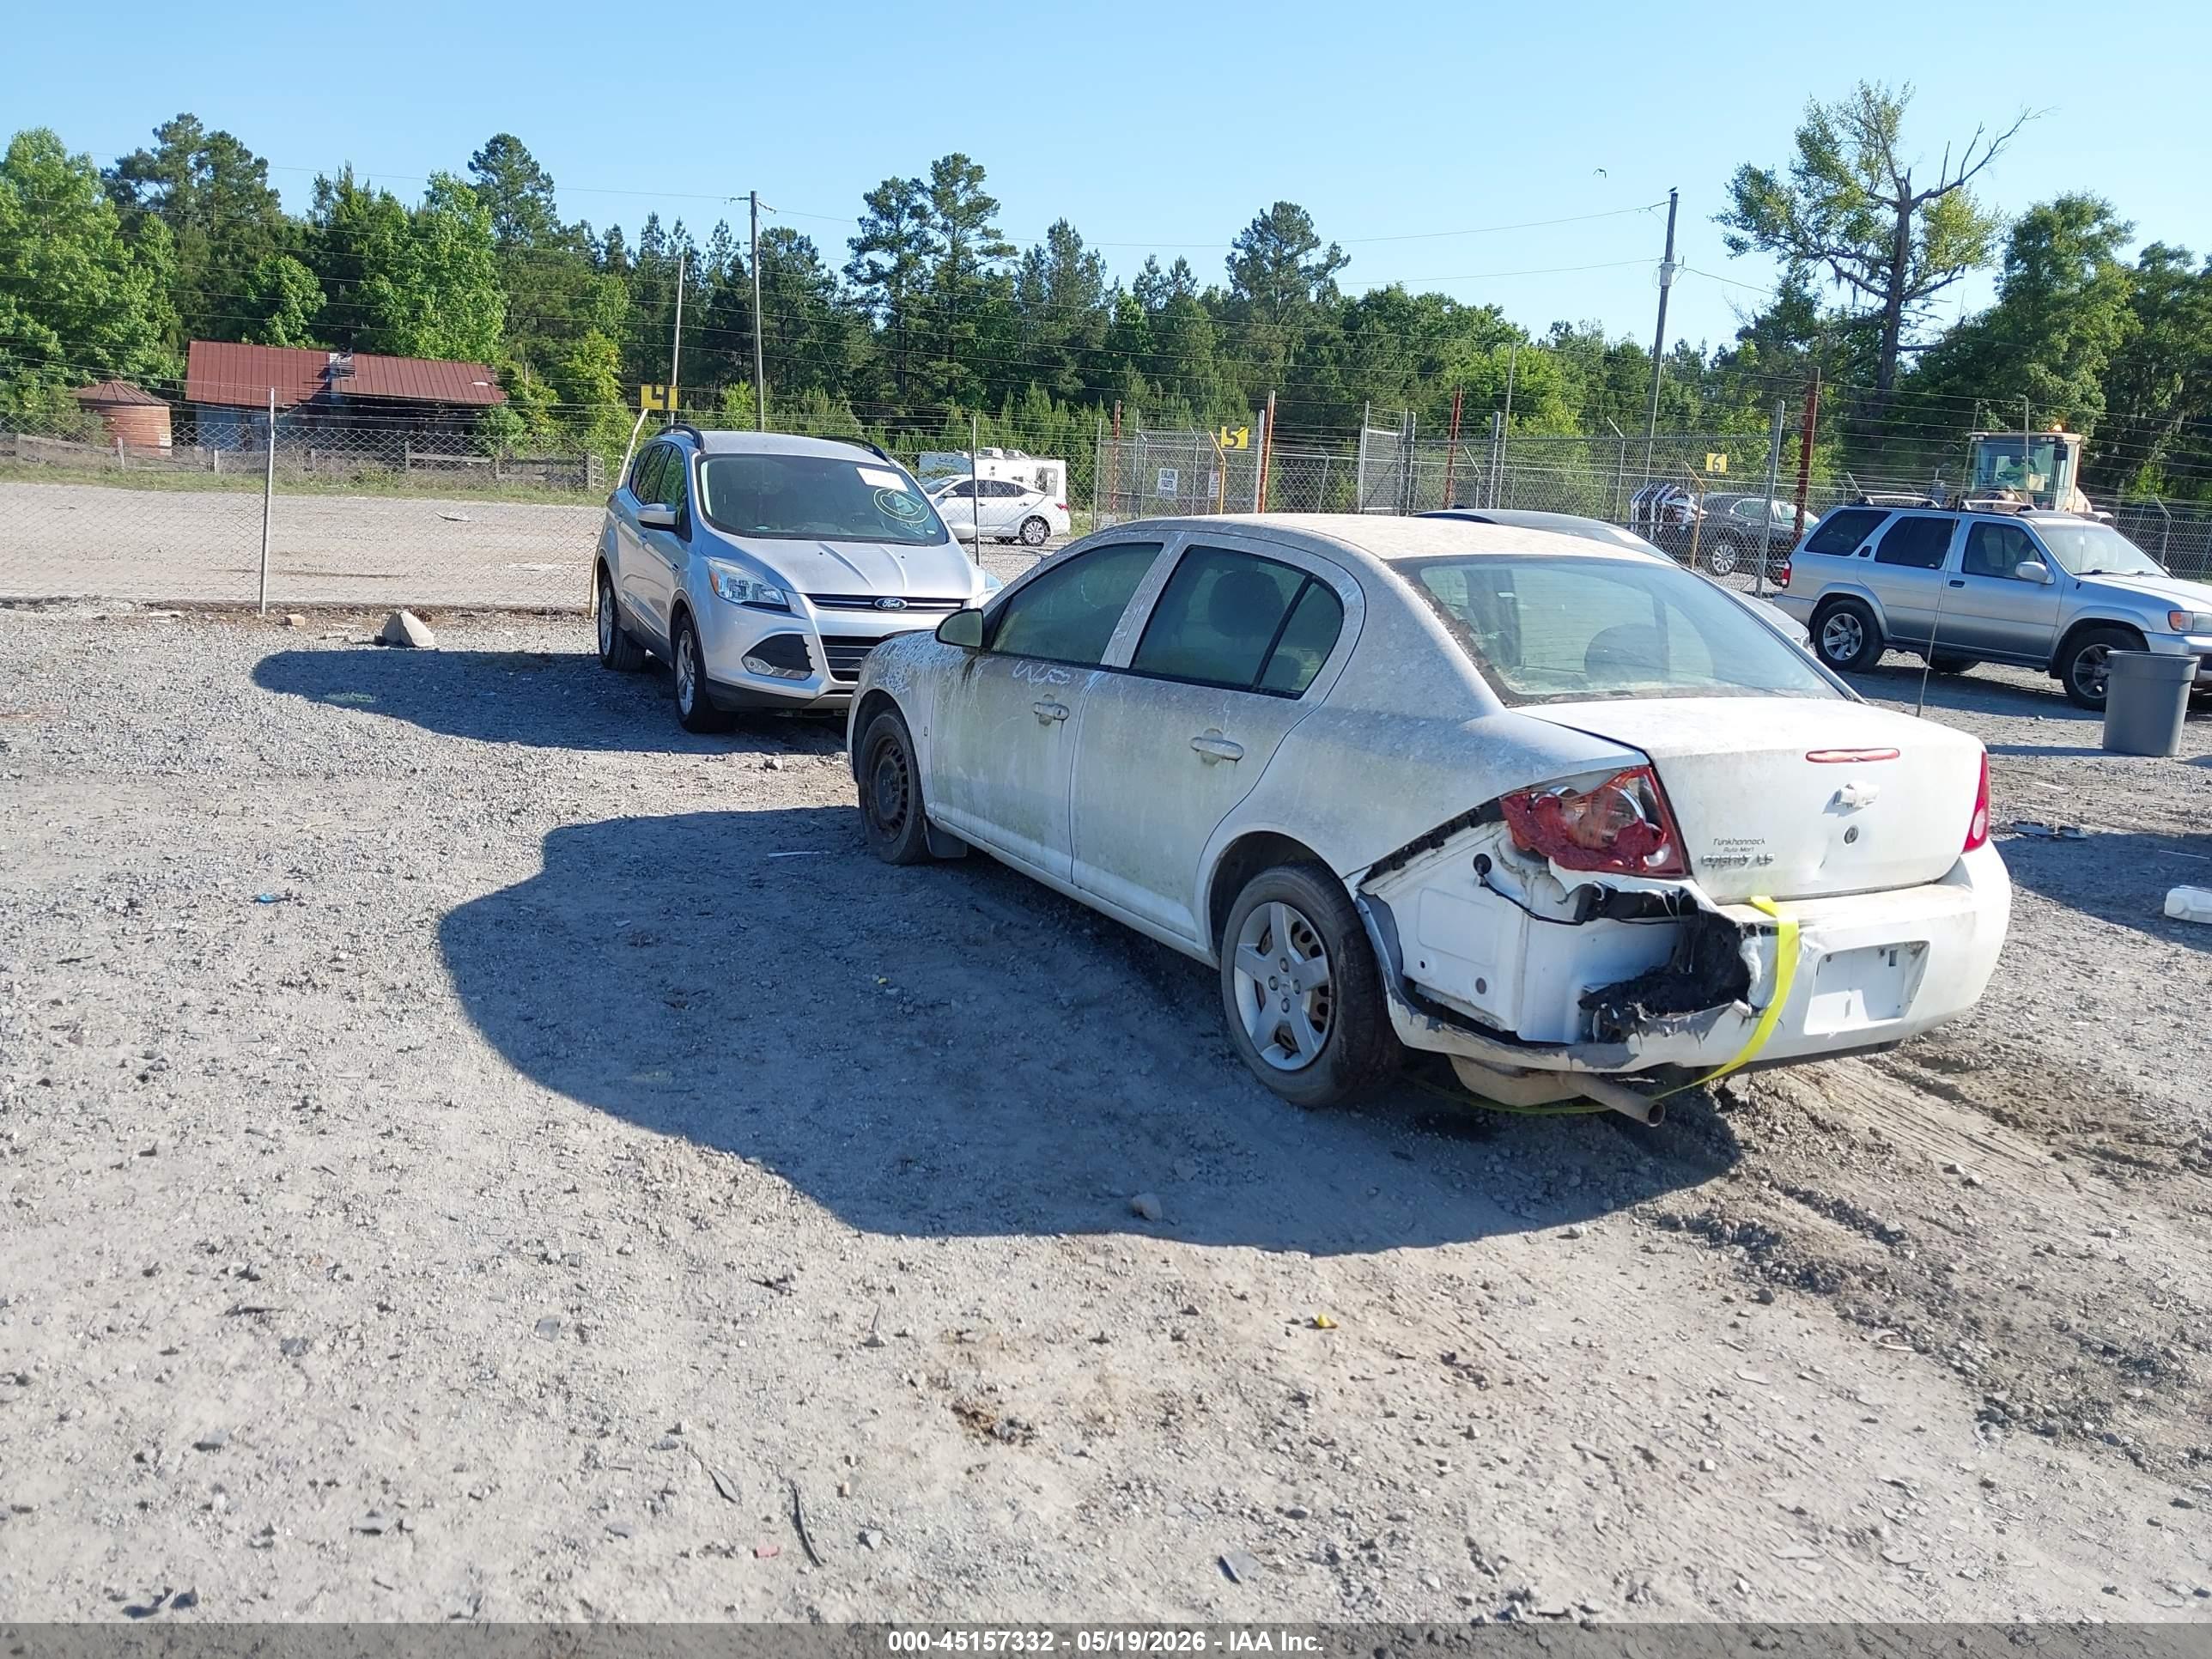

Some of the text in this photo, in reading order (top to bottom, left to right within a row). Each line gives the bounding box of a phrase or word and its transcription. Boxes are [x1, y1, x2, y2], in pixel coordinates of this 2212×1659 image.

[651, 384, 669, 410] 4
[1224, 425, 1241, 447] 5
[1711, 453, 1723, 471] 6
[882, 599, 901, 608] Ford
